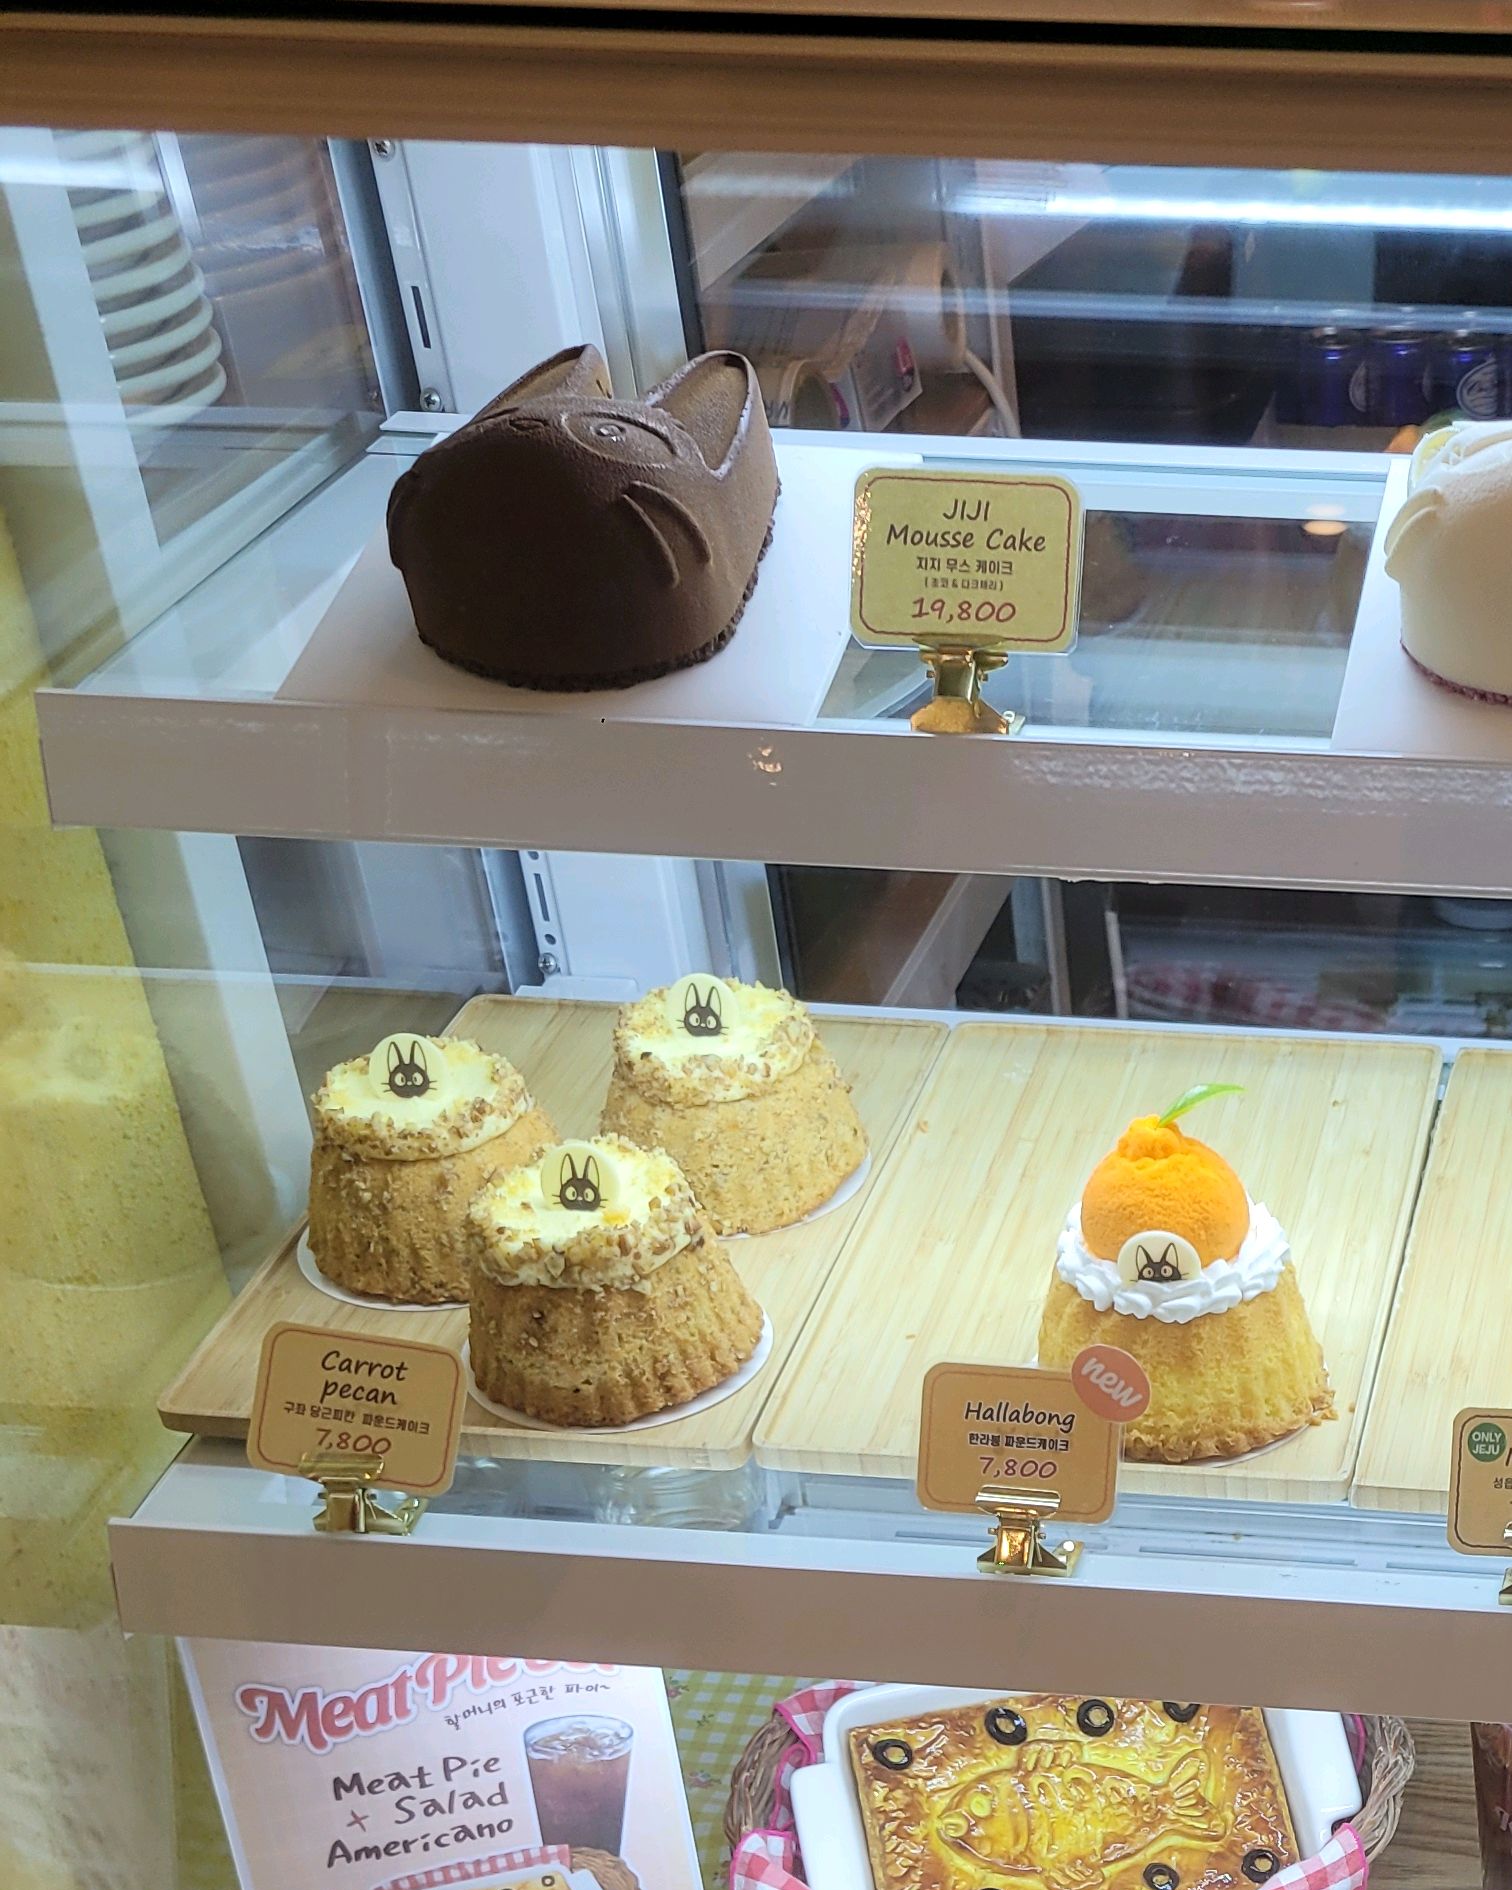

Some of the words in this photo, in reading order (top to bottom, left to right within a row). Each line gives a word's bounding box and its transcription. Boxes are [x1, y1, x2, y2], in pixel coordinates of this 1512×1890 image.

[943, 498, 991, 522] JIJI
[886, 524, 975, 549] Mousse
[985, 528, 1047, 552] Cake
[916, 556, 941, 571] 지지
[946, 558, 970, 573] 무스
[976, 560, 1013, 575] 케이크
[911, 597, 1016, 624] 19,800
[321, 1350, 408, 1382] Carrot
[319, 1379, 398, 1406] pecan
[1081, 1357, 1143, 1408] new
[310, 1404, 355, 1424] 당근피칸
[362, 1413, 430, 1435] 파운드케이크
[964, 1402, 1076, 1434] Hallabong
[316, 1427, 392, 1455] 7,800
[969, 1433, 1001, 1447] 한라봉
[1005, 1435, 1069, 1451] 파운드케이크
[1471, 1431, 1502, 1443] ONLY
[1472, 1444, 1500, 1455] JEJU
[979, 1456, 1057, 1479] 7,800
[240, 1667, 413, 1750] Meat
[444, 1698, 507, 1731] 할머니의
[511, 1685, 556, 1706] 포근한
[332, 1766, 435, 1801] Meat
[442, 1756, 501, 1782] Pie
[394, 1781, 509, 1825] Salad
[327, 1818, 513, 1869] Americano
